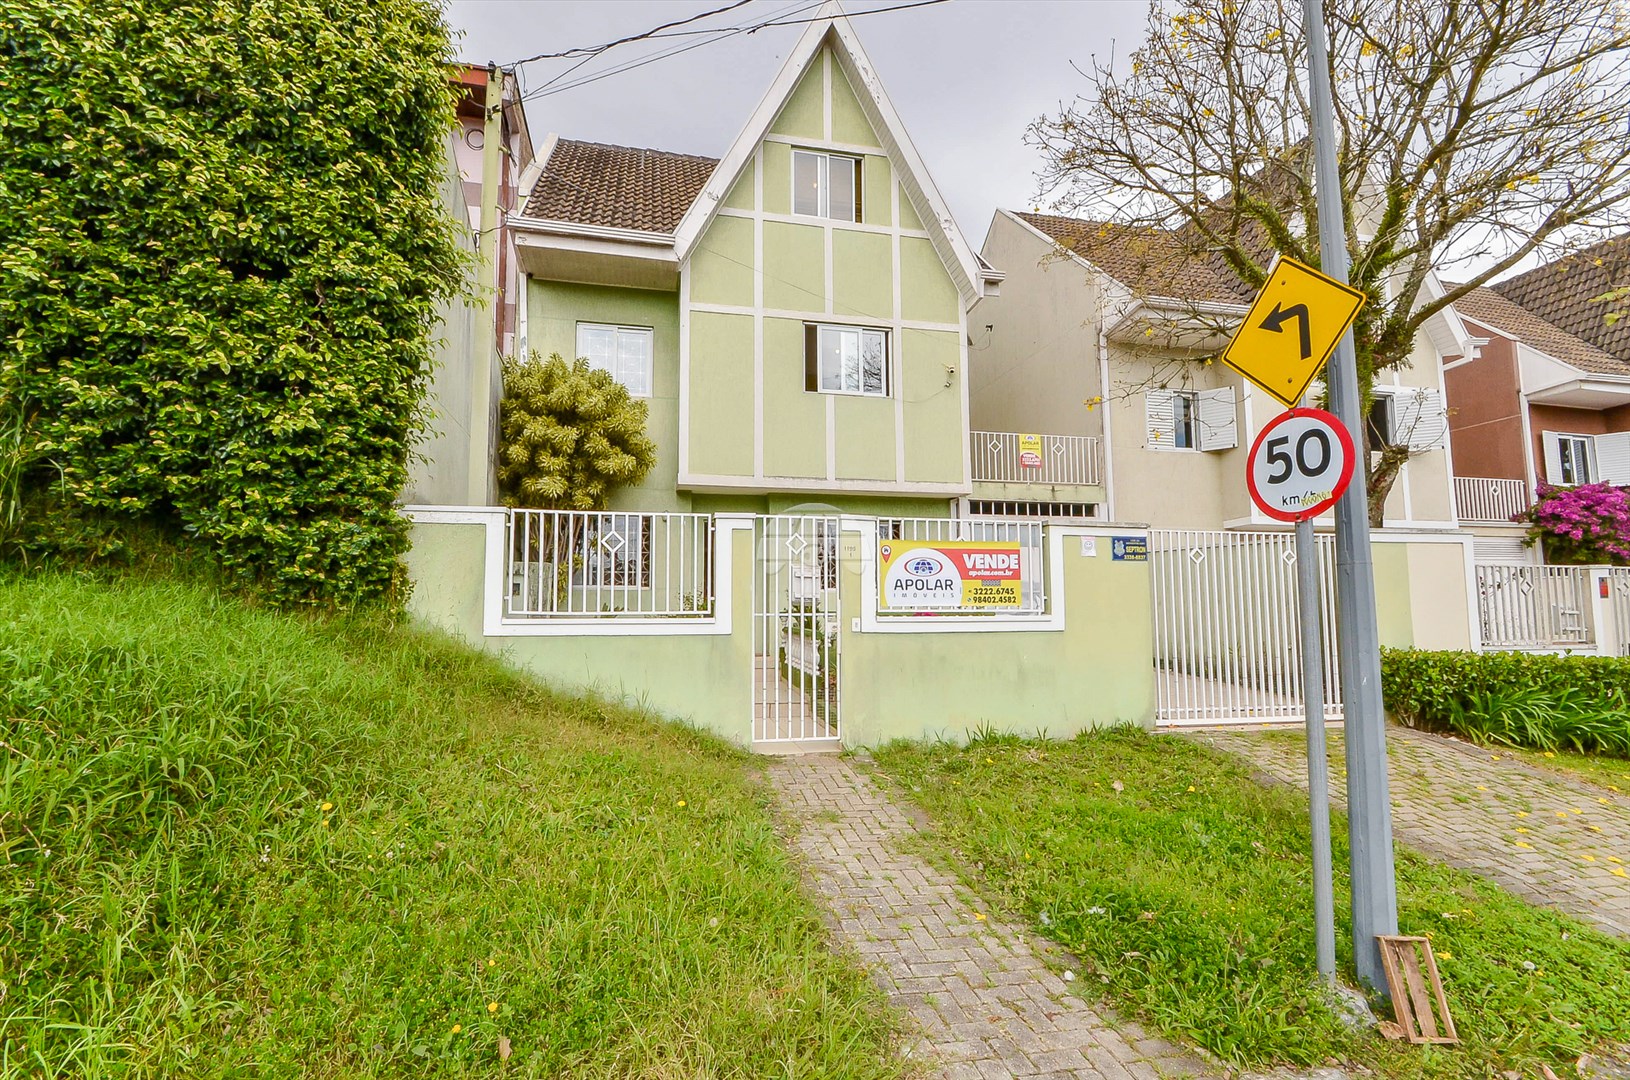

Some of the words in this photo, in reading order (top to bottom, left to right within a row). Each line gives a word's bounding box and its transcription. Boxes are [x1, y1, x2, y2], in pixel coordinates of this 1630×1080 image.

[1267, 428, 1331, 485] 50
[962, 554, 1019, 569] VENDE
[893, 579, 954, 591] APOLAR
[973, 587, 1015, 596] 3222.6745
[972, 596, 1017, 604] 98402.4582
